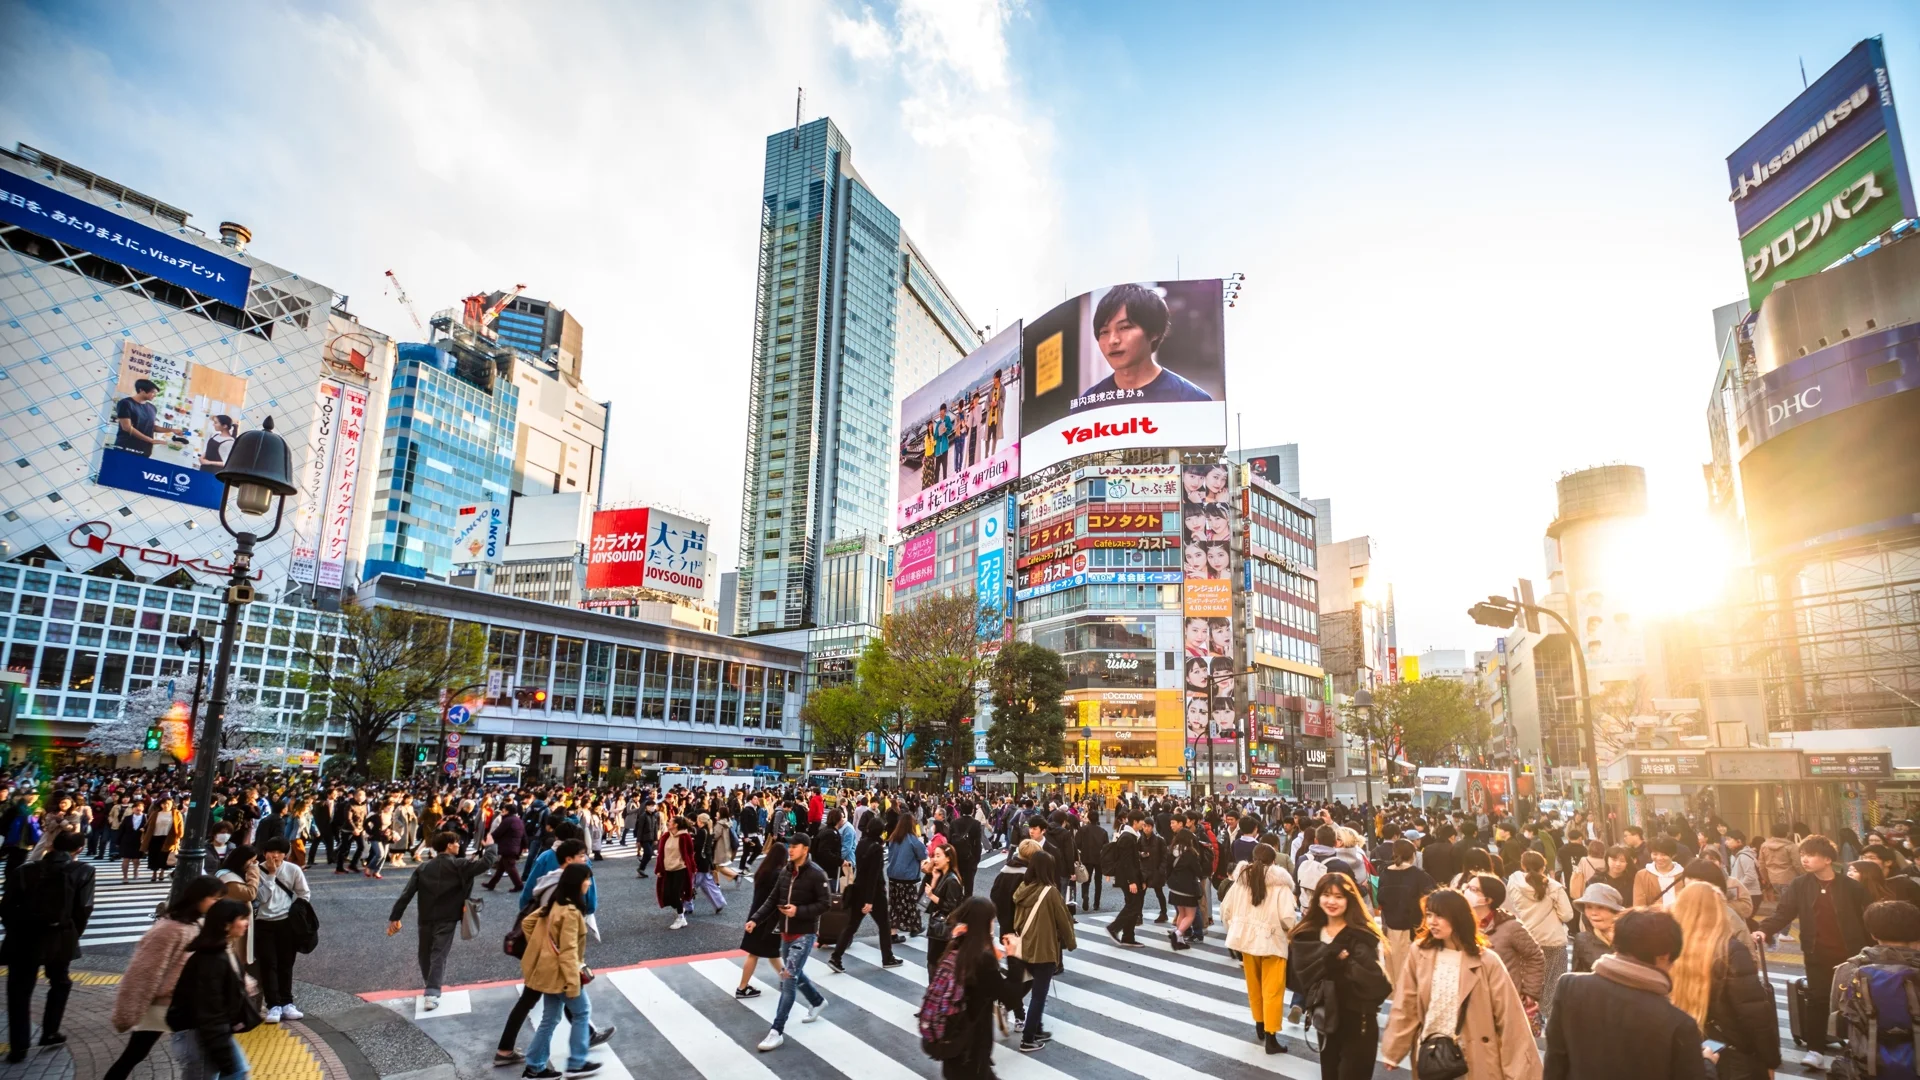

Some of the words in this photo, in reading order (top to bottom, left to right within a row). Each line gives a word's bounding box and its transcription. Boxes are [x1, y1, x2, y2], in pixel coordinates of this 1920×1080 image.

[1729, 84, 1870, 202] Hisamitsu
[1745, 171, 1884, 282] サロンパス
[131, 349, 176, 367] Visaが使える
[128, 364, 171, 381] Visaデビット
[1070, 388, 1144, 410] 腸内環境改善かぁ
[1767, 385, 1822, 427] DHC
[1062, 416, 1158, 445] Yakult
[142, 470, 168, 484] VISA
[972, 459, 1008, 486] 4月7日(日)
[1098, 466, 1176, 475] しゃぶしゃぶバイキング
[1130, 481, 1177, 496] しゃぶ葉
[1020, 509, 1030, 520] 9F
[1088, 514, 1160, 528] コンタクト
[454, 510, 488, 546] SANKYO
[486, 508, 502, 557] SANKYO
[592, 532, 645, 551] カラオケ
[650, 521, 706, 554] 大声
[1138, 538, 1172, 550] ガスト
[591, 550, 644, 564] JOYSOUND
[1054, 543, 1078, 560] ガスト
[106, 541, 263, 581] TOKYU
[645, 566, 703, 590] JOYSOUND
[900, 565, 933, 586] 品川美容外科
[1020, 574, 1029, 586] 7F
[1044, 562, 1071, 582] ガスト
[1118, 573, 1181, 582] 英会話イーオン
[1308, 714, 1321, 724] アコム
[1306, 750, 1326, 763] LUSH
[1641, 764, 1676, 774] 渋谷駅
